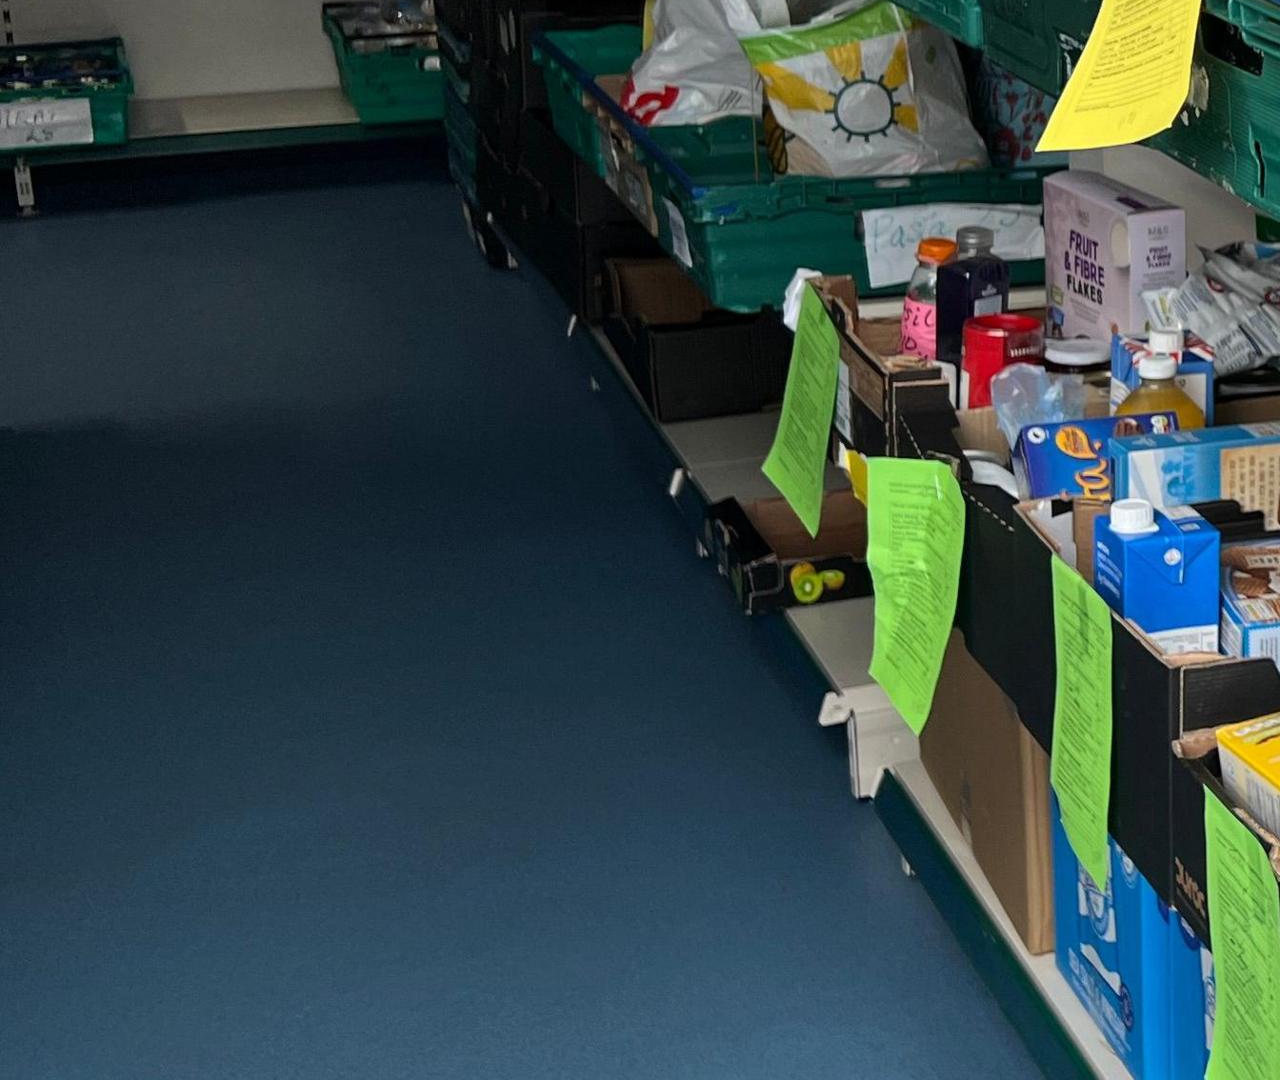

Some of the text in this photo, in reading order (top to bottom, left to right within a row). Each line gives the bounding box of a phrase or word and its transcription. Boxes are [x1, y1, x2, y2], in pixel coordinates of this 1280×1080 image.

[1069, 230, 1099, 262] FRUIT
[1064, 251, 1105, 288] & FIBRE
[1067, 274, 1103, 305] FLAKES
